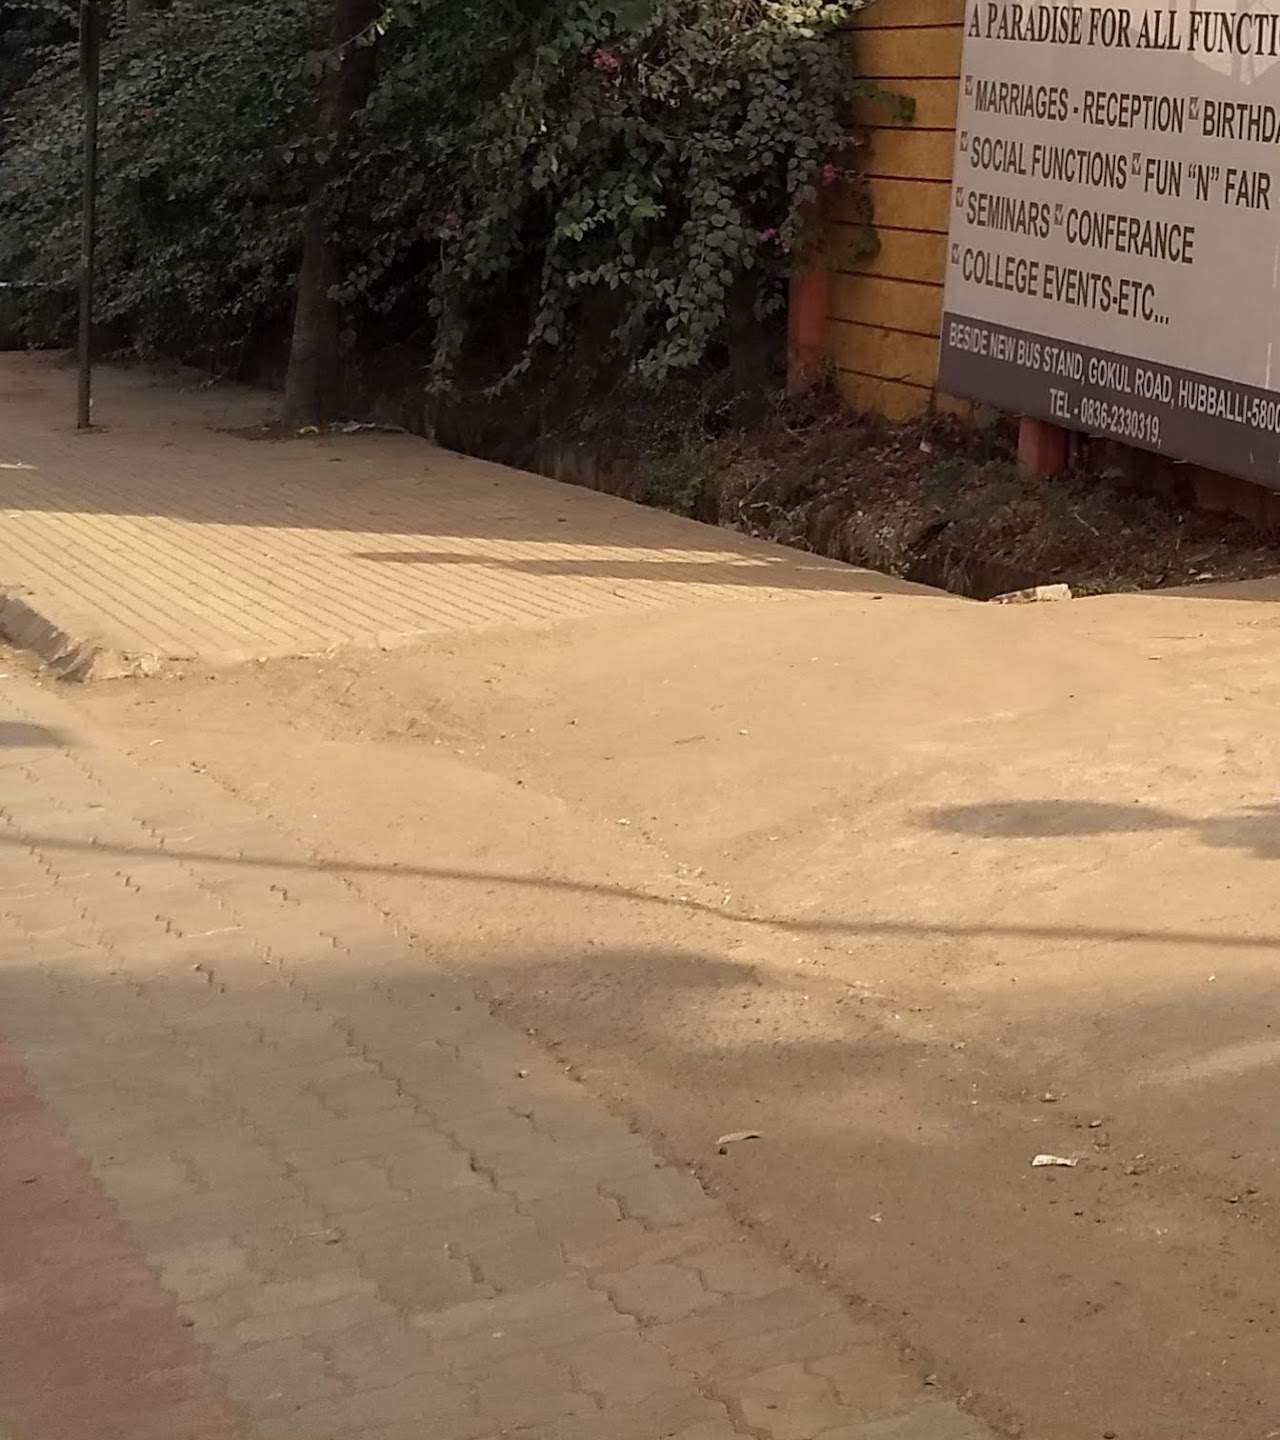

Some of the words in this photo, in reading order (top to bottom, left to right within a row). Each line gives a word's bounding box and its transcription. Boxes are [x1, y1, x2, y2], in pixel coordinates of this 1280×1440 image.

[967, 3, 980, 38] A
[985, 3, 1083, 46] PARADISE
[1087, 7, 1132, 48] FOR
[1135, 9, 1183, 51] ALL
[974, 79, 1070, 122] MARRIAGES
[1082, 90, 1185, 134] RECEPTION
[970, 136, 1027, 176] SOCIAL
[1031, 144, 1128, 190] FUNCTIONS
[1144, 157, 1182, 198] FUN
[1224, 168, 1272, 211] FAIR
[965, 191, 1050, 239] SEMINARS
[1065, 207, 1196, 265] CONFERANCE
[962, 247, 1040, 297] COLLEGE
[949, 322, 988, 356] BESIDE
[988, 333, 1016, 362] NEW
[1017, 339, 1042, 370] BUS
[1042, 347, 1086, 386] STAND,
[1088, 358, 1132, 394] GOKUL
[1134, 367, 1176, 409] ROAD,
[1049, 388, 1071, 419] TEL
